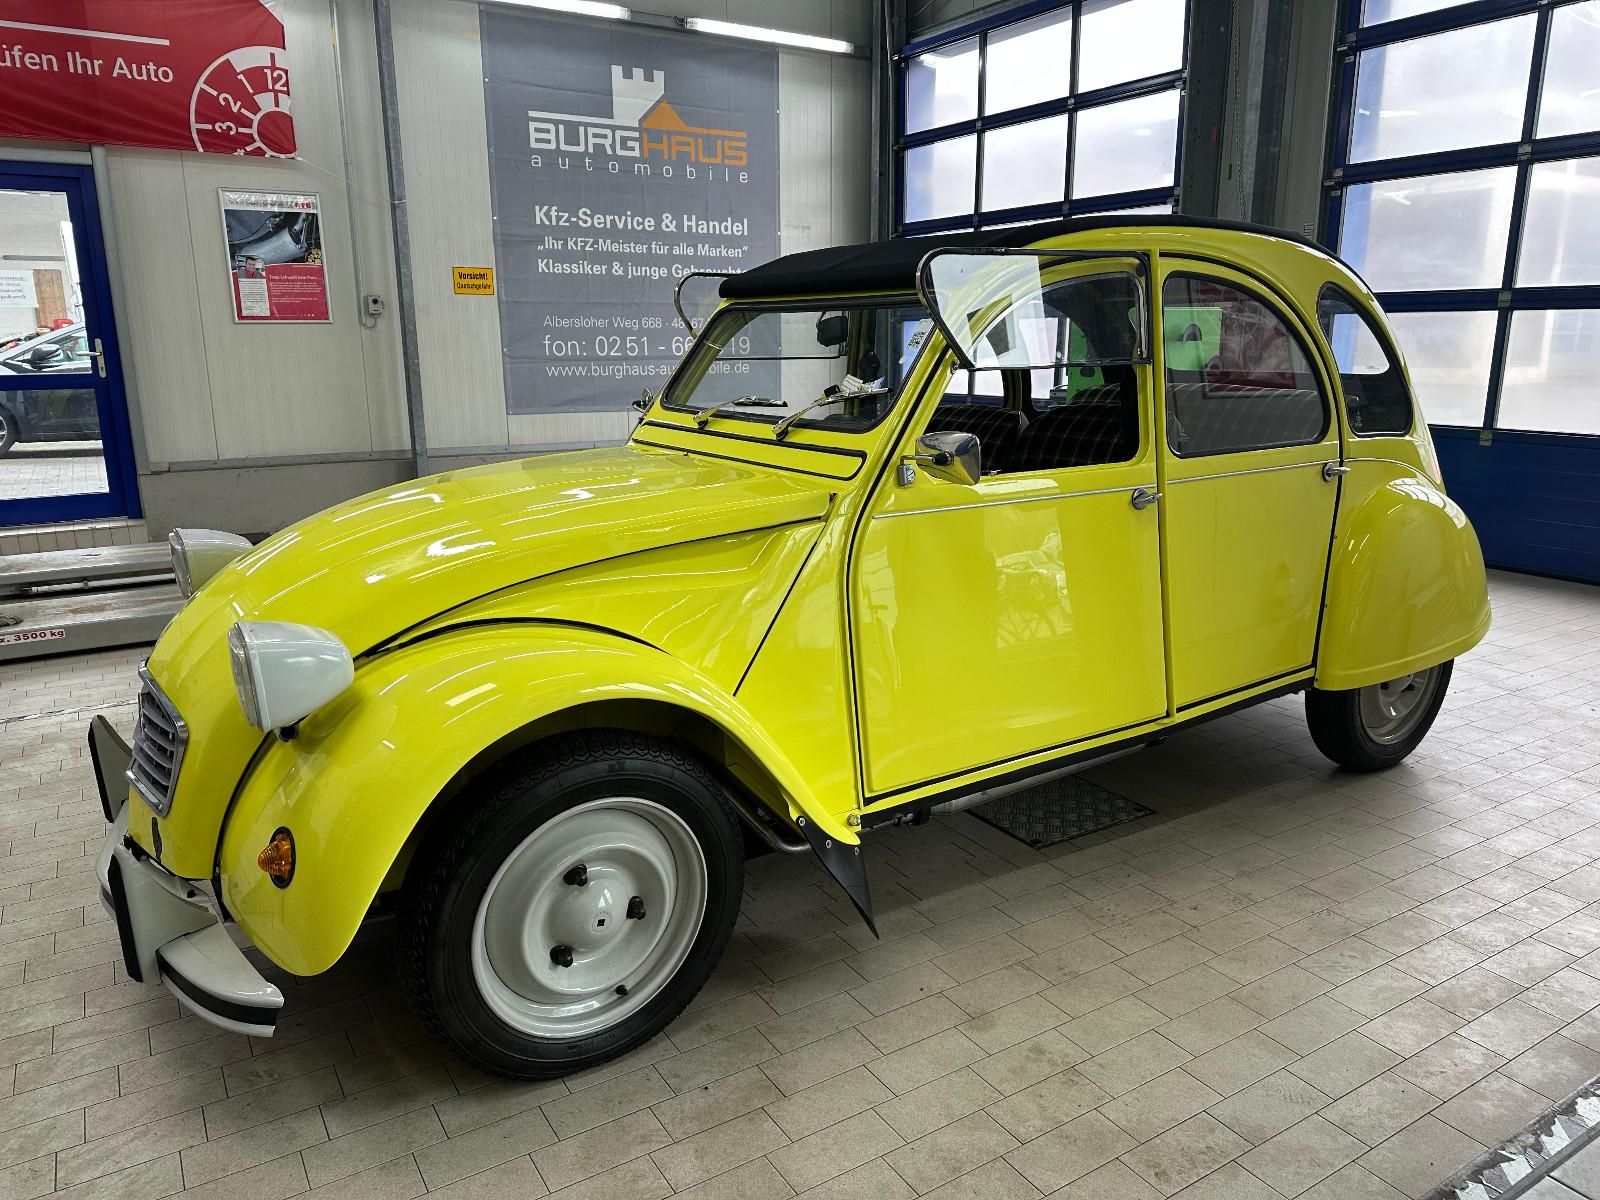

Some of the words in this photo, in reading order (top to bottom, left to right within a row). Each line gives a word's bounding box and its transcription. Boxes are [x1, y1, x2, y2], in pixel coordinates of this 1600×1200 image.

[67, 51, 103, 76] Ihr
[112, 57, 174, 83] Auto
[237, 73, 254, 93] 1
[264, 69, 288, 91] 12
[218, 93, 241, 113] 2
[214, 121, 237, 136] 3
[528, 121, 748, 166] BURGHAUS
[531, 154, 748, 183] automobile
[534, 205, 655, 231] Kfz-Service
[661, 212, 677, 232] &
[683, 214, 748, 235] Handel
[567, 237, 647, 253] KFZ-Meister
[651, 241, 669, 255] für
[672, 243, 694, 256] alle
[458, 271, 488, 280] Vorsicht!
[538, 259, 607, 275] Klassiker
[612, 261, 624, 275] &
[628, 262, 667, 279] junge
[672, 263, 746, 278] Gebrauht
[543, 315, 609, 328] Albersloher
[612, 317, 639, 330] Weg
[641, 317, 662, 329] 668
[671, 317, 704, 329] 4867
[542, 335, 587, 356] fon:
[14, 631, 47, 641] 3500
[50, 630, 65, 638] kg
